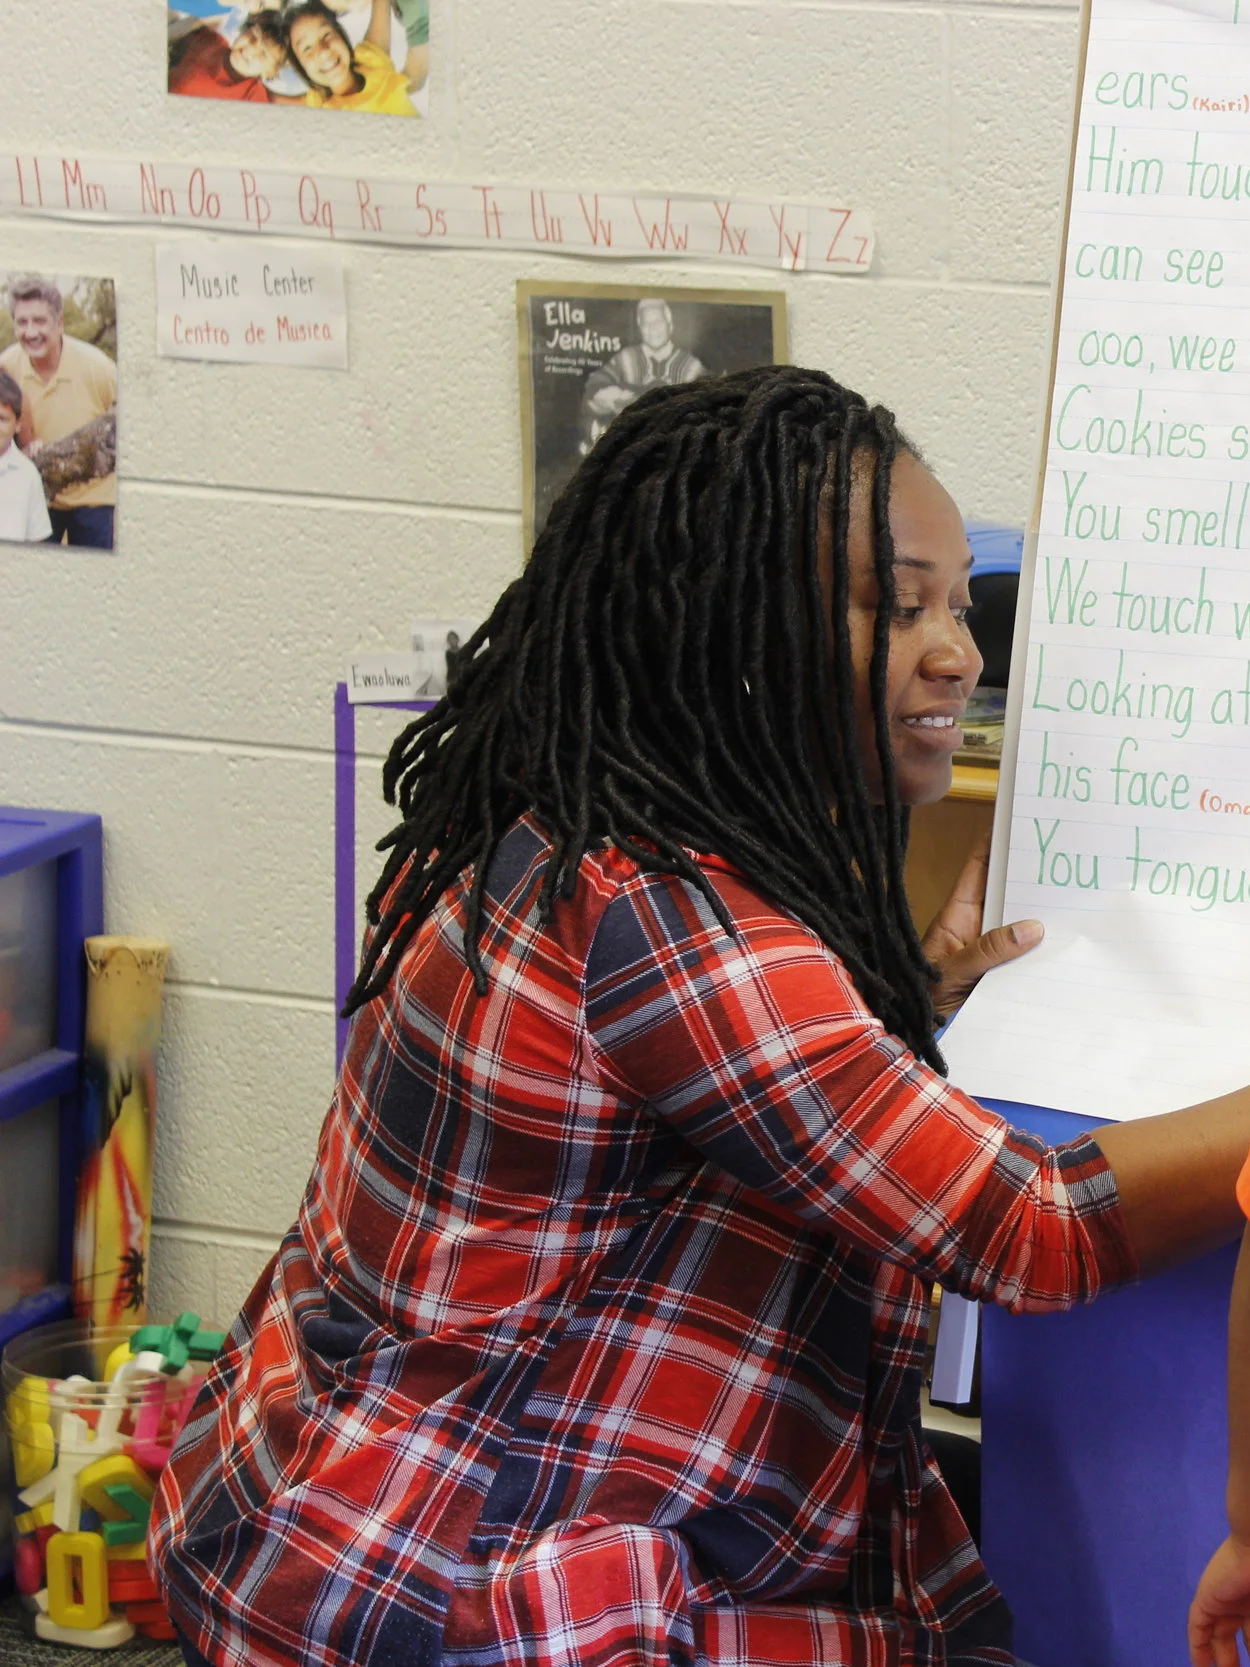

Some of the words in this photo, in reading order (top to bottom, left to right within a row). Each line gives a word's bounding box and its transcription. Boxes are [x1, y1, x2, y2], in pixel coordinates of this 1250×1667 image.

[1092, 69, 1191, 111] ears
[1193, 94, 1250, 115] (Kairi)
[1085, 125, 1165, 198] Him
[14, 155, 44, 208] Ll
[60, 157, 108, 214] Mm
[138, 160, 178, 218] Nn
[186, 166, 223, 221] Oo
[239, 168, 273, 232] Pp
[297, 174, 336, 240] Qq
[355, 178, 384, 235] Rr
[414, 182, 449, 239] Ss
[470, 184, 503, 240] Tt
[529, 188, 564, 245] Uu
[577, 191, 613, 249] Vv
[632, 195, 690, 252] Ww
[712, 198, 749, 257] Xx
[767, 202, 802, 272] Yy
[824, 206, 870, 266] Zz
[178, 262, 242, 300] Music
[261, 262, 318, 298] Center
[1074, 242, 1144, 283] can
[1162, 247, 1225, 289] see
[172, 314, 231, 348] Centro
[243, 320, 268, 346] de
[543, 301, 586, 326] Ella
[546, 329, 621, 354] Jenkins
[1078, 330, 1156, 374] ooo,
[1168, 334, 1237, 373] wee
[1055, 383, 1207, 461] Cookies
[1060, 469, 1121, 541] You
[1141, 480, 1250, 551] smell
[1044, 555, 1099, 629] We
[1111, 561, 1214, 635] touch
[1031, 643, 1196, 738] Looking
[1036, 730, 1092, 803] his
[1109, 736, 1191, 811] face
[1034, 817, 1099, 887] You
